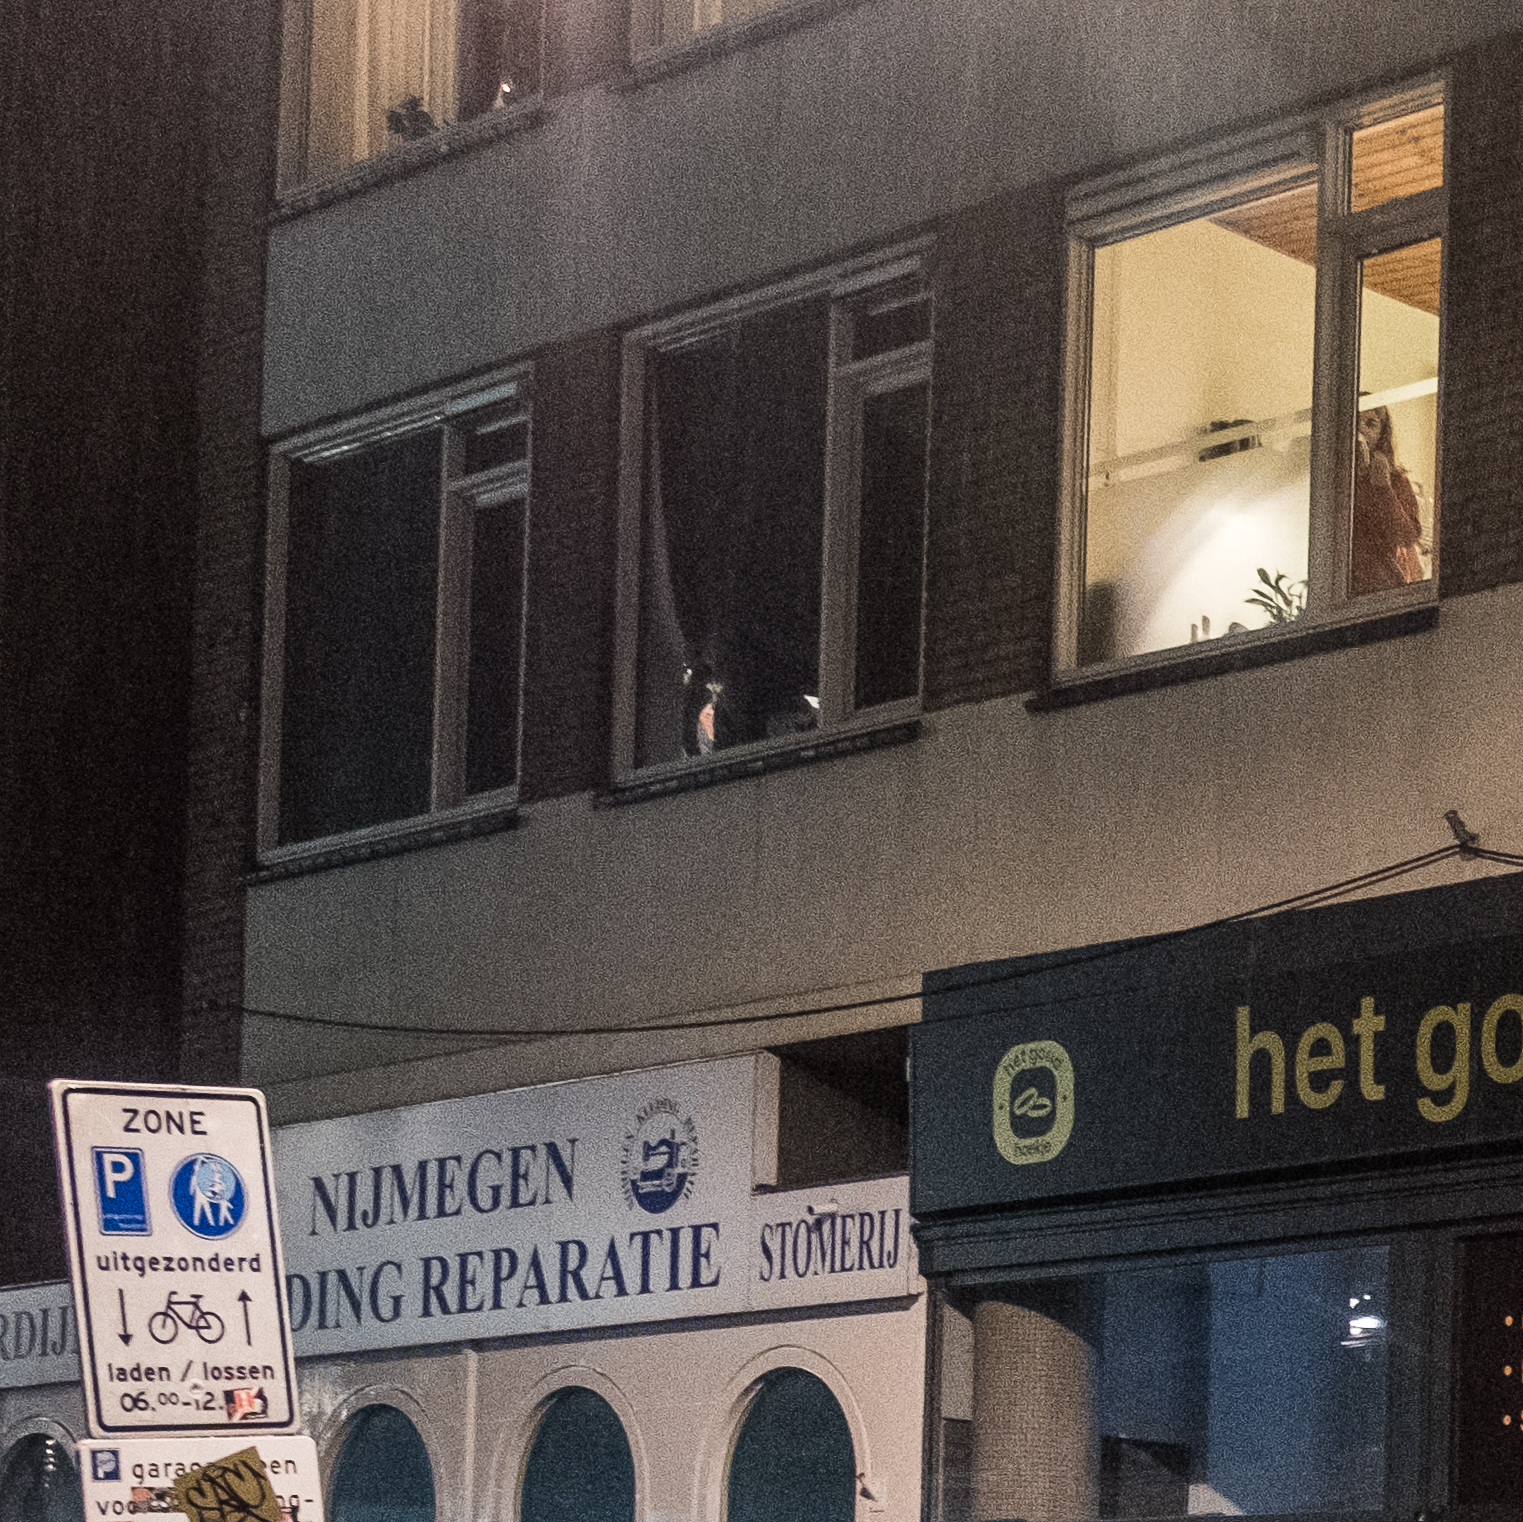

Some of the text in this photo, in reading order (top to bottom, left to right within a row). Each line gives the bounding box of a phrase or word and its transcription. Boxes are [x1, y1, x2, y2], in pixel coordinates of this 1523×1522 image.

[1235, 996, 1390, 1119] het
[121, 1108, 209, 1136] ZONE
[103, 1153, 134, 1198] P
[308, 1138, 580, 1237] NIJMEGEN
[96, 1252, 262, 1278] uitgezonderd
[418, 1222, 721, 1320] REPARATIE
[759, 1207, 902, 1284] STOMERIJ
[108, 1362, 171, 1382] laden
[203, 1362, 275, 1381] lossen
